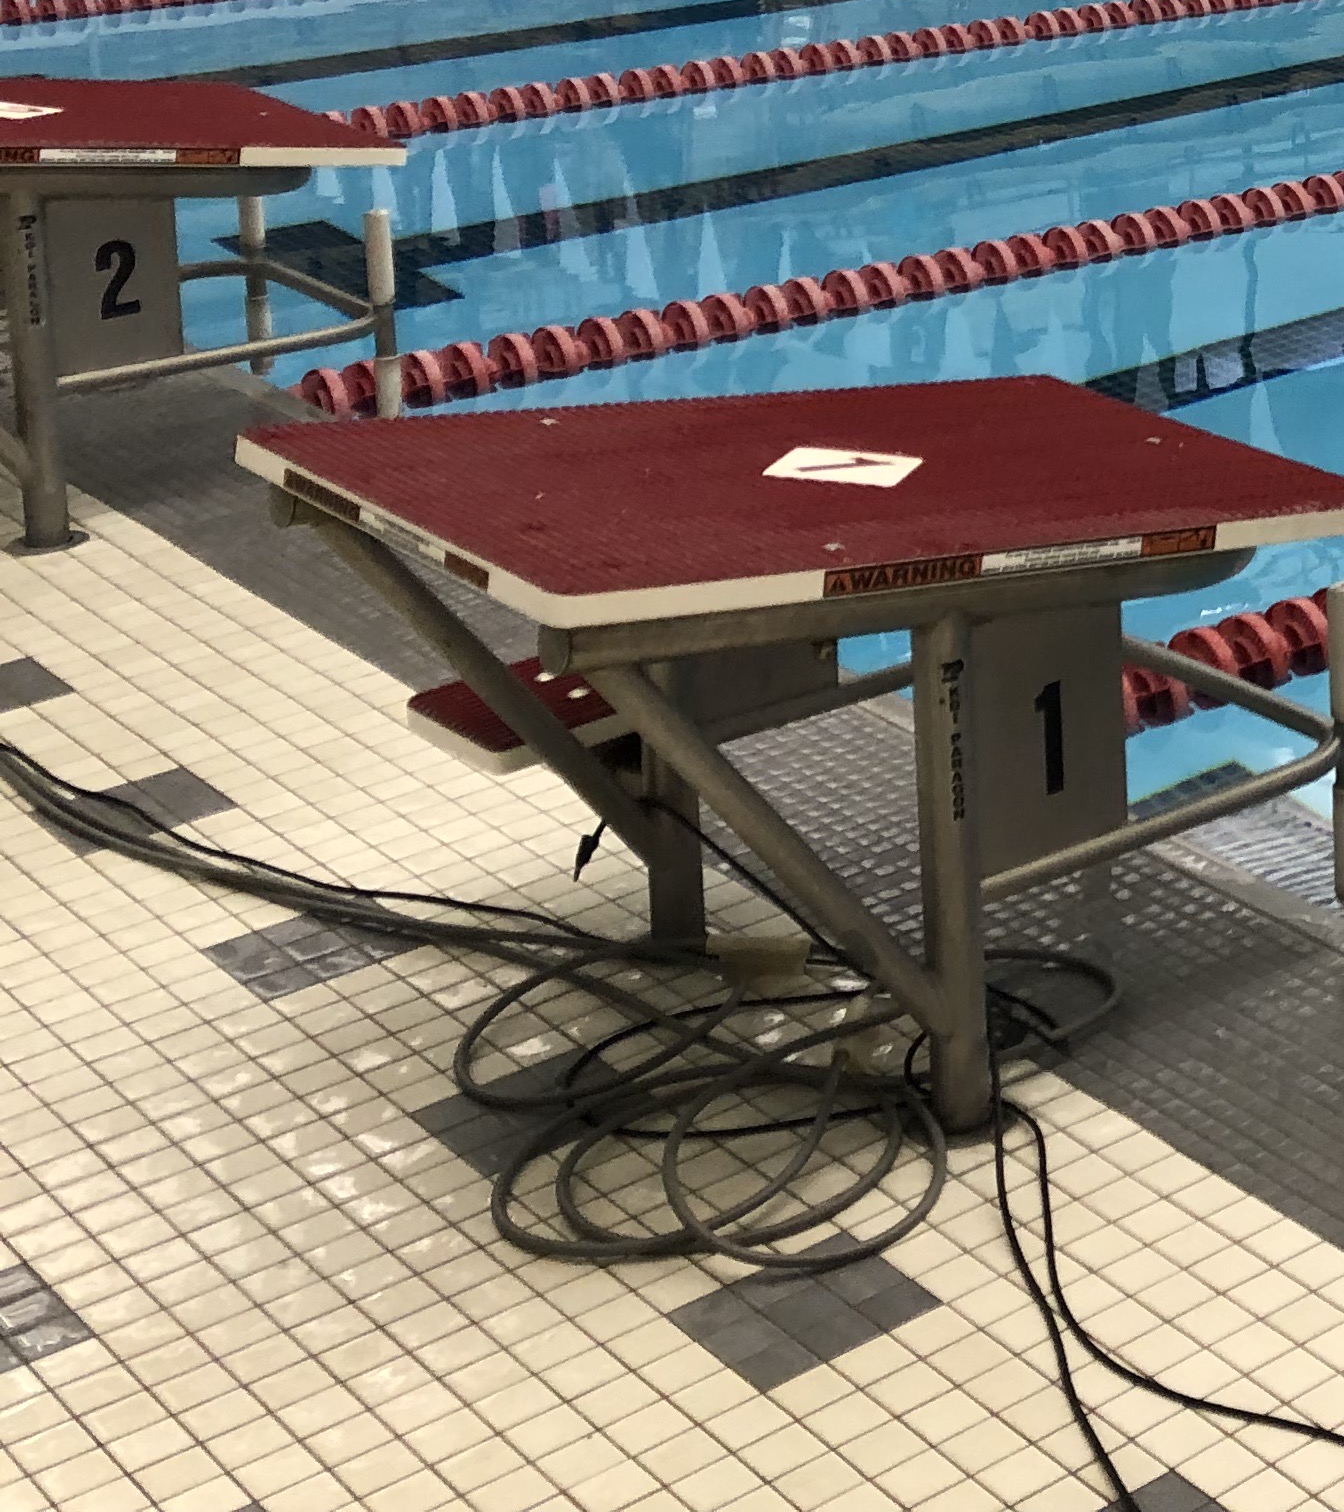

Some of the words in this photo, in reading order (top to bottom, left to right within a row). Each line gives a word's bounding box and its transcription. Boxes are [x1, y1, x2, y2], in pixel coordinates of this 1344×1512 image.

[95, 239, 141, 320] 2
[851, 559, 977, 592] WARNING
[1034, 679, 1065, 796] 1
